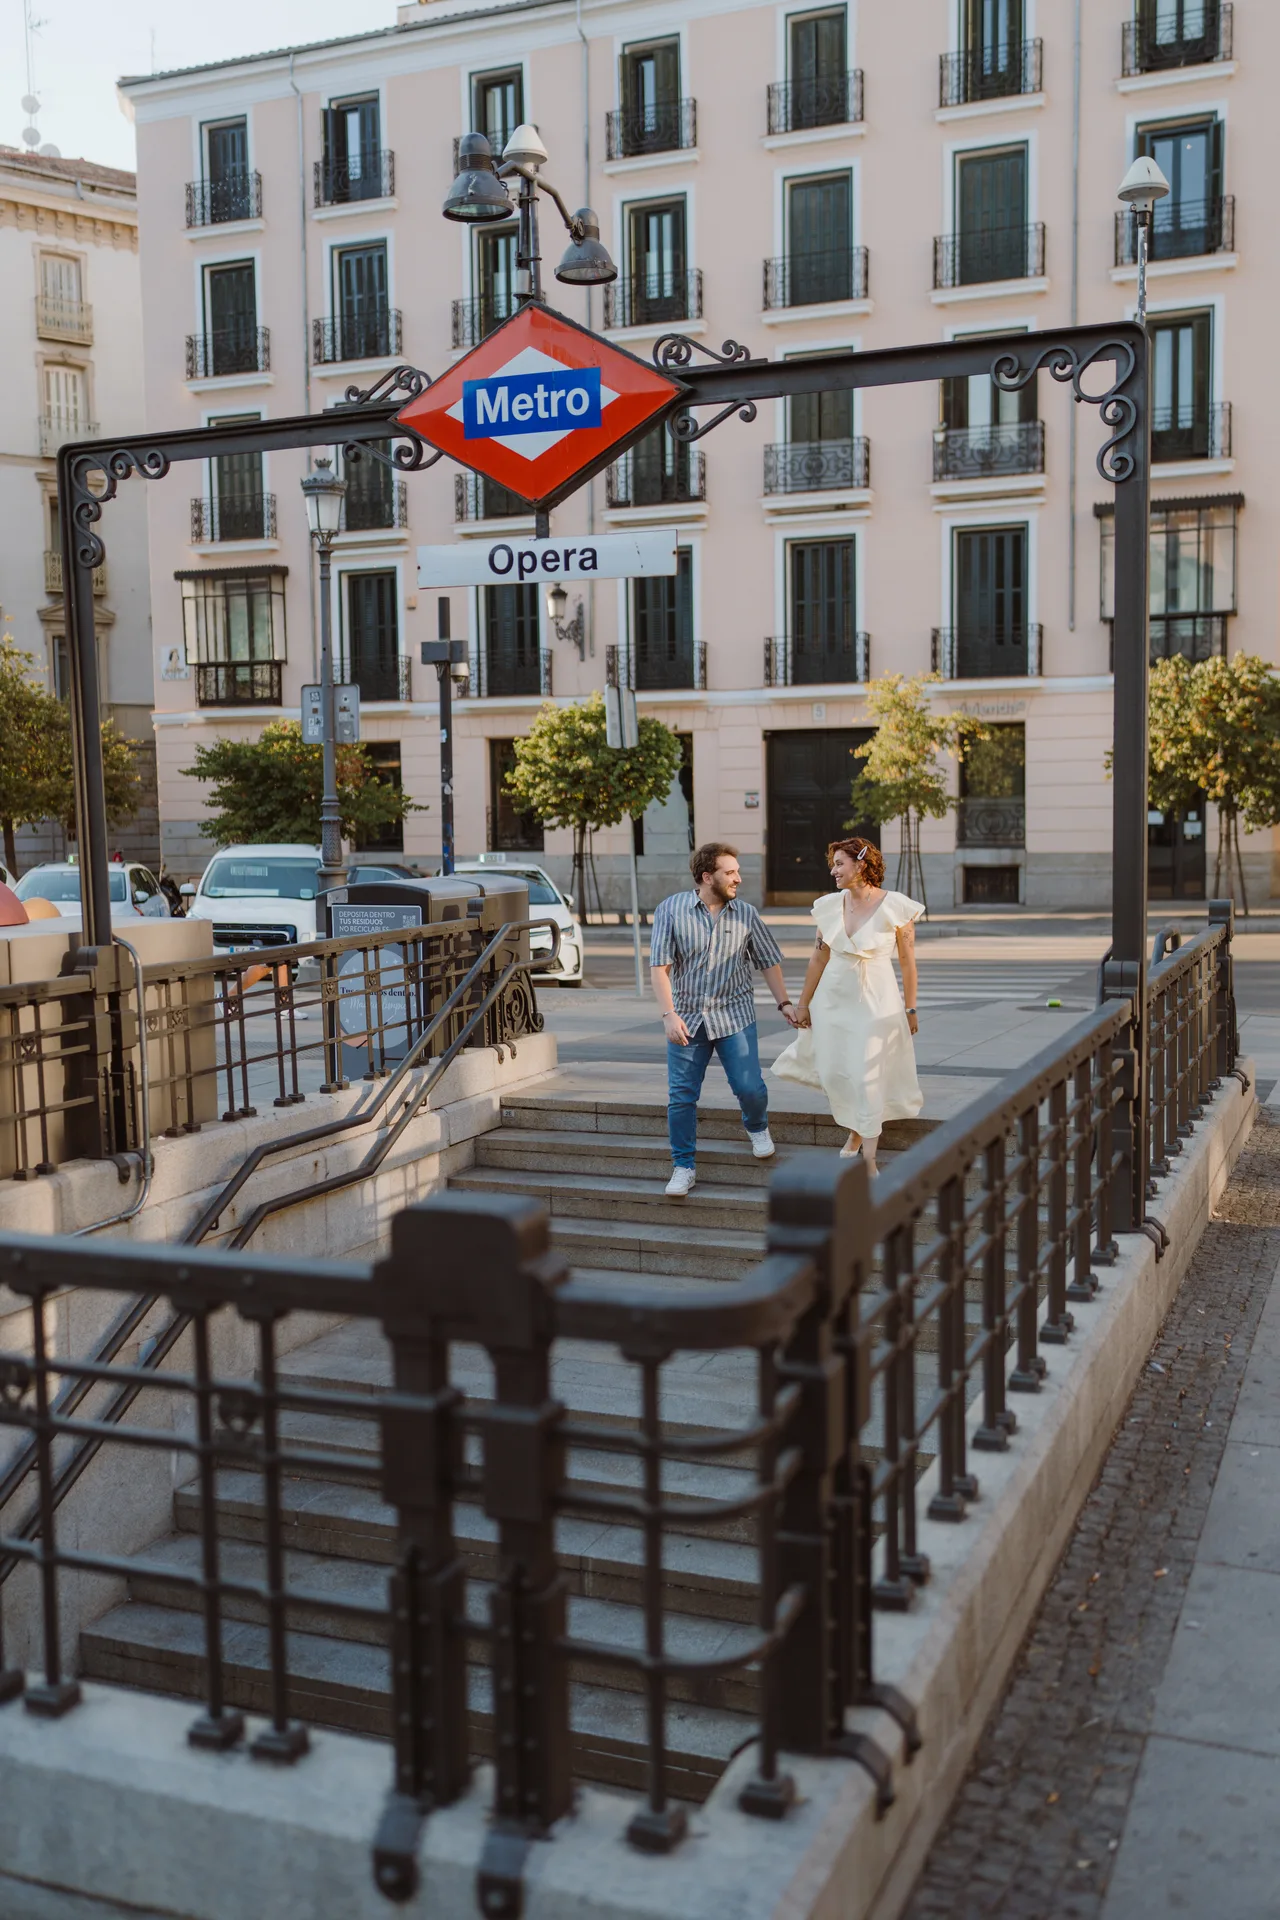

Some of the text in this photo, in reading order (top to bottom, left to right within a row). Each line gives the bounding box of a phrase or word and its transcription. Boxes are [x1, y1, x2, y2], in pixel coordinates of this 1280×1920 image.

[476, 384, 590, 425] Metro
[488, 543, 598, 581] Opera
[369, 911, 395, 919] DENTRO
